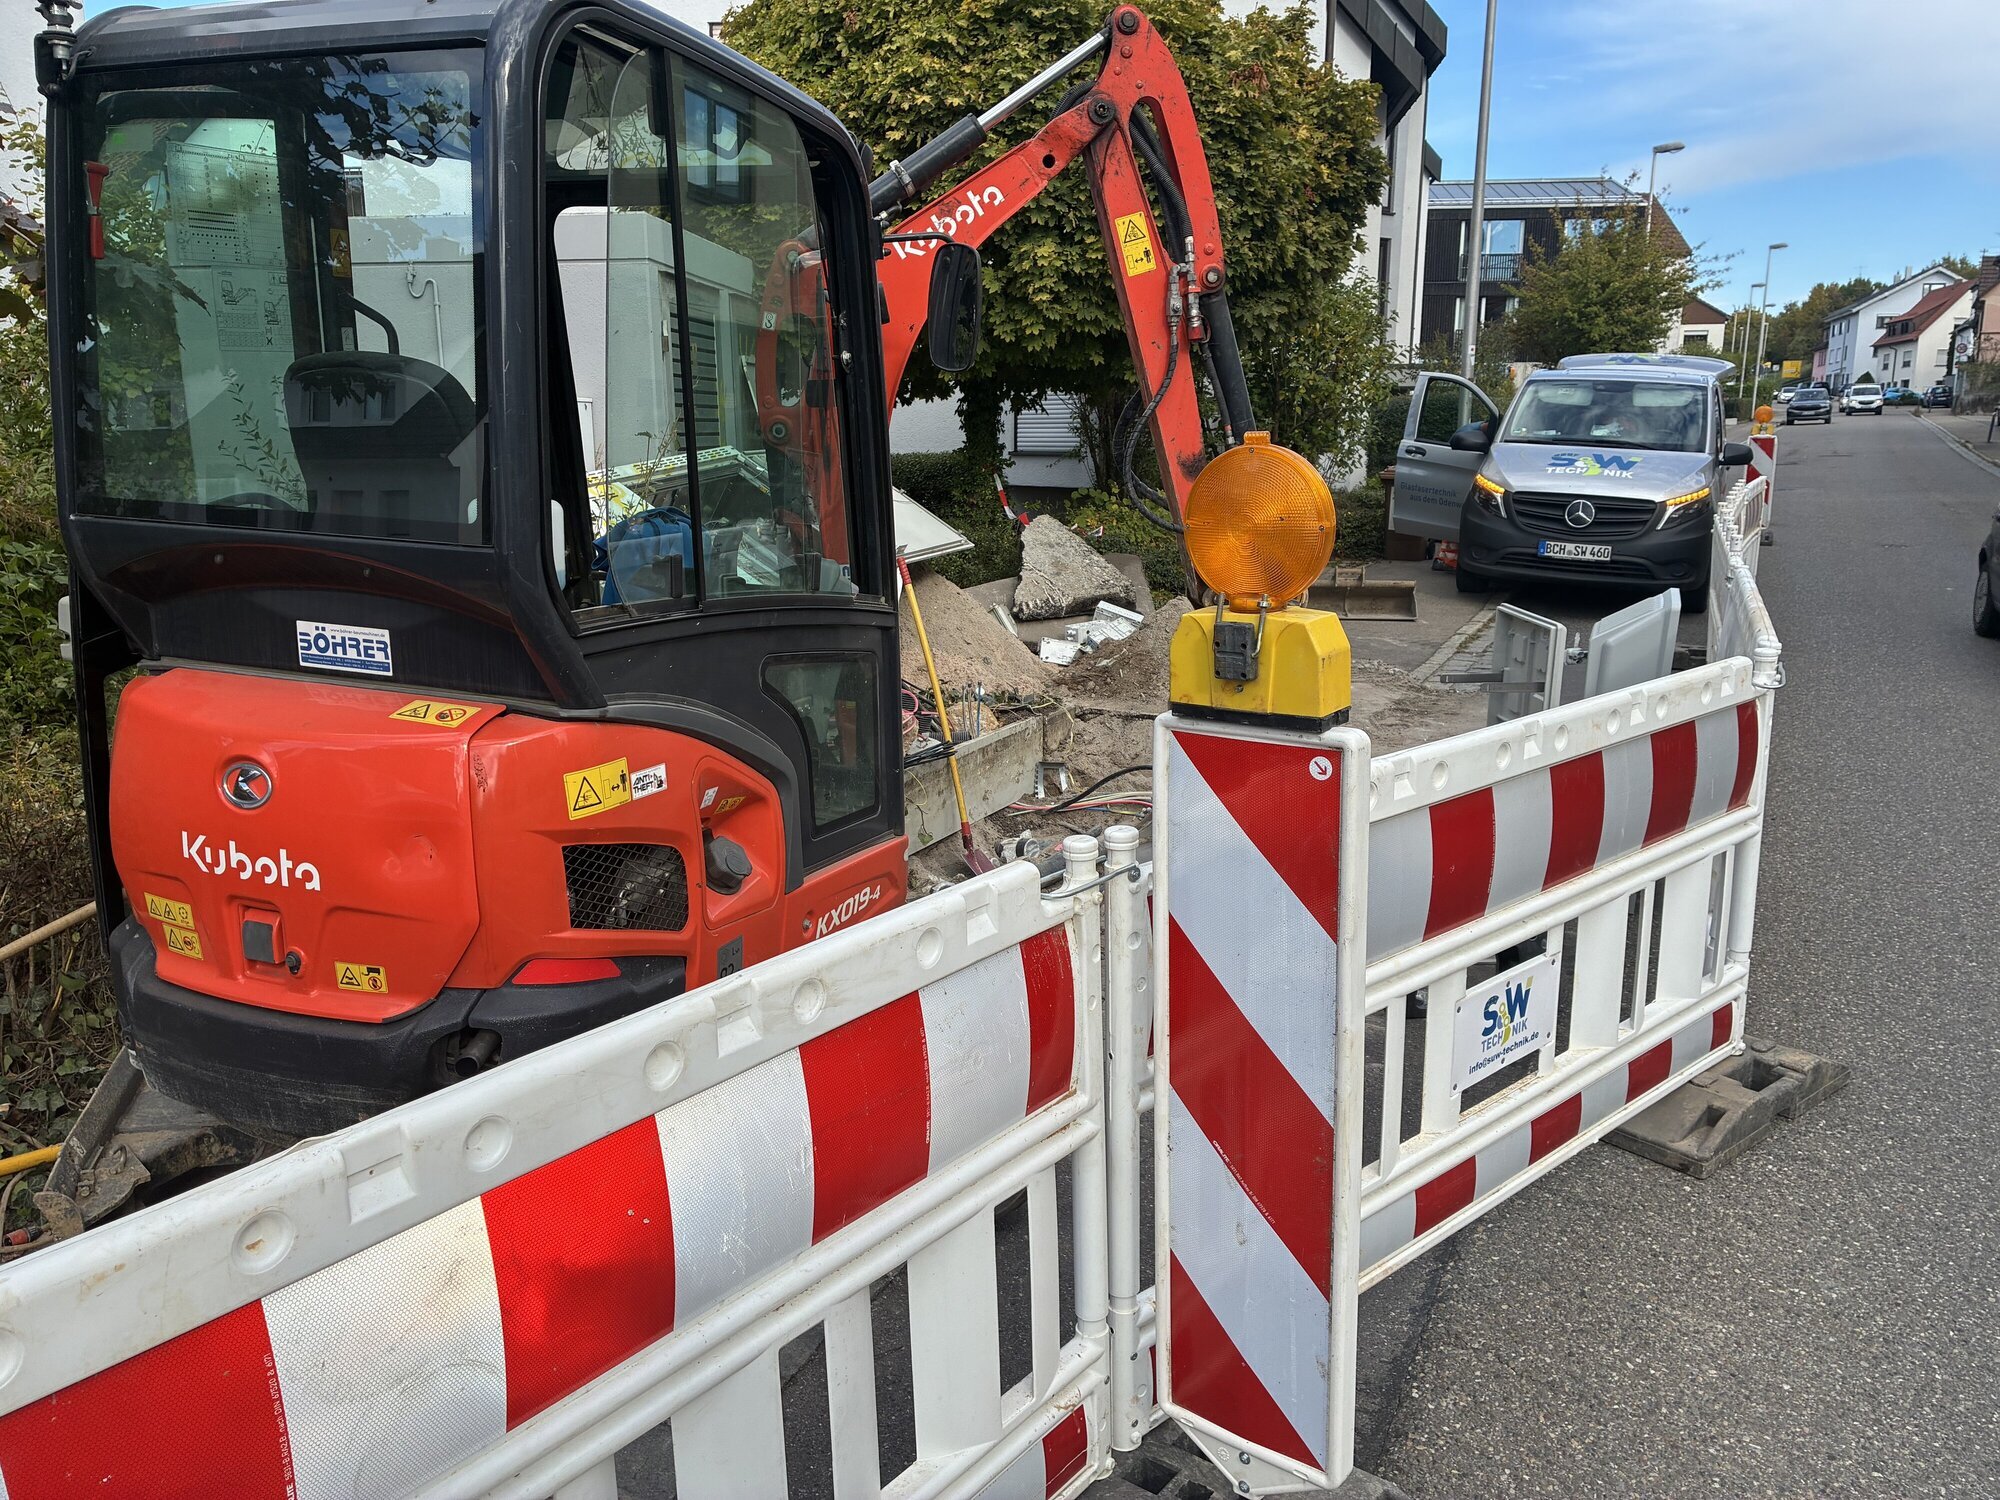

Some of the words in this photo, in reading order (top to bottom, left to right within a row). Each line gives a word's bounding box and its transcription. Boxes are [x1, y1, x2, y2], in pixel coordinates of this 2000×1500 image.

[893, 186, 1005, 260] Kubota
[1401, 482, 1458, 497] Glasfasertechnik
[1546, 543, 1566, 556] BCH
[1573, 545, 1588, 557] SW
[1589, 547, 1610, 559] 460
[299, 625, 390, 661] BÖHRER
[633, 780, 655, 795] THEFT
[182, 830, 321, 892] Kubota
[815, 884, 881, 940] KX019-4
[1469, 1031, 1540, 1075] info@suw-technik.de
[268, 1378, 280, 1399] 67520
[273, 1400, 282, 1415] DIN
